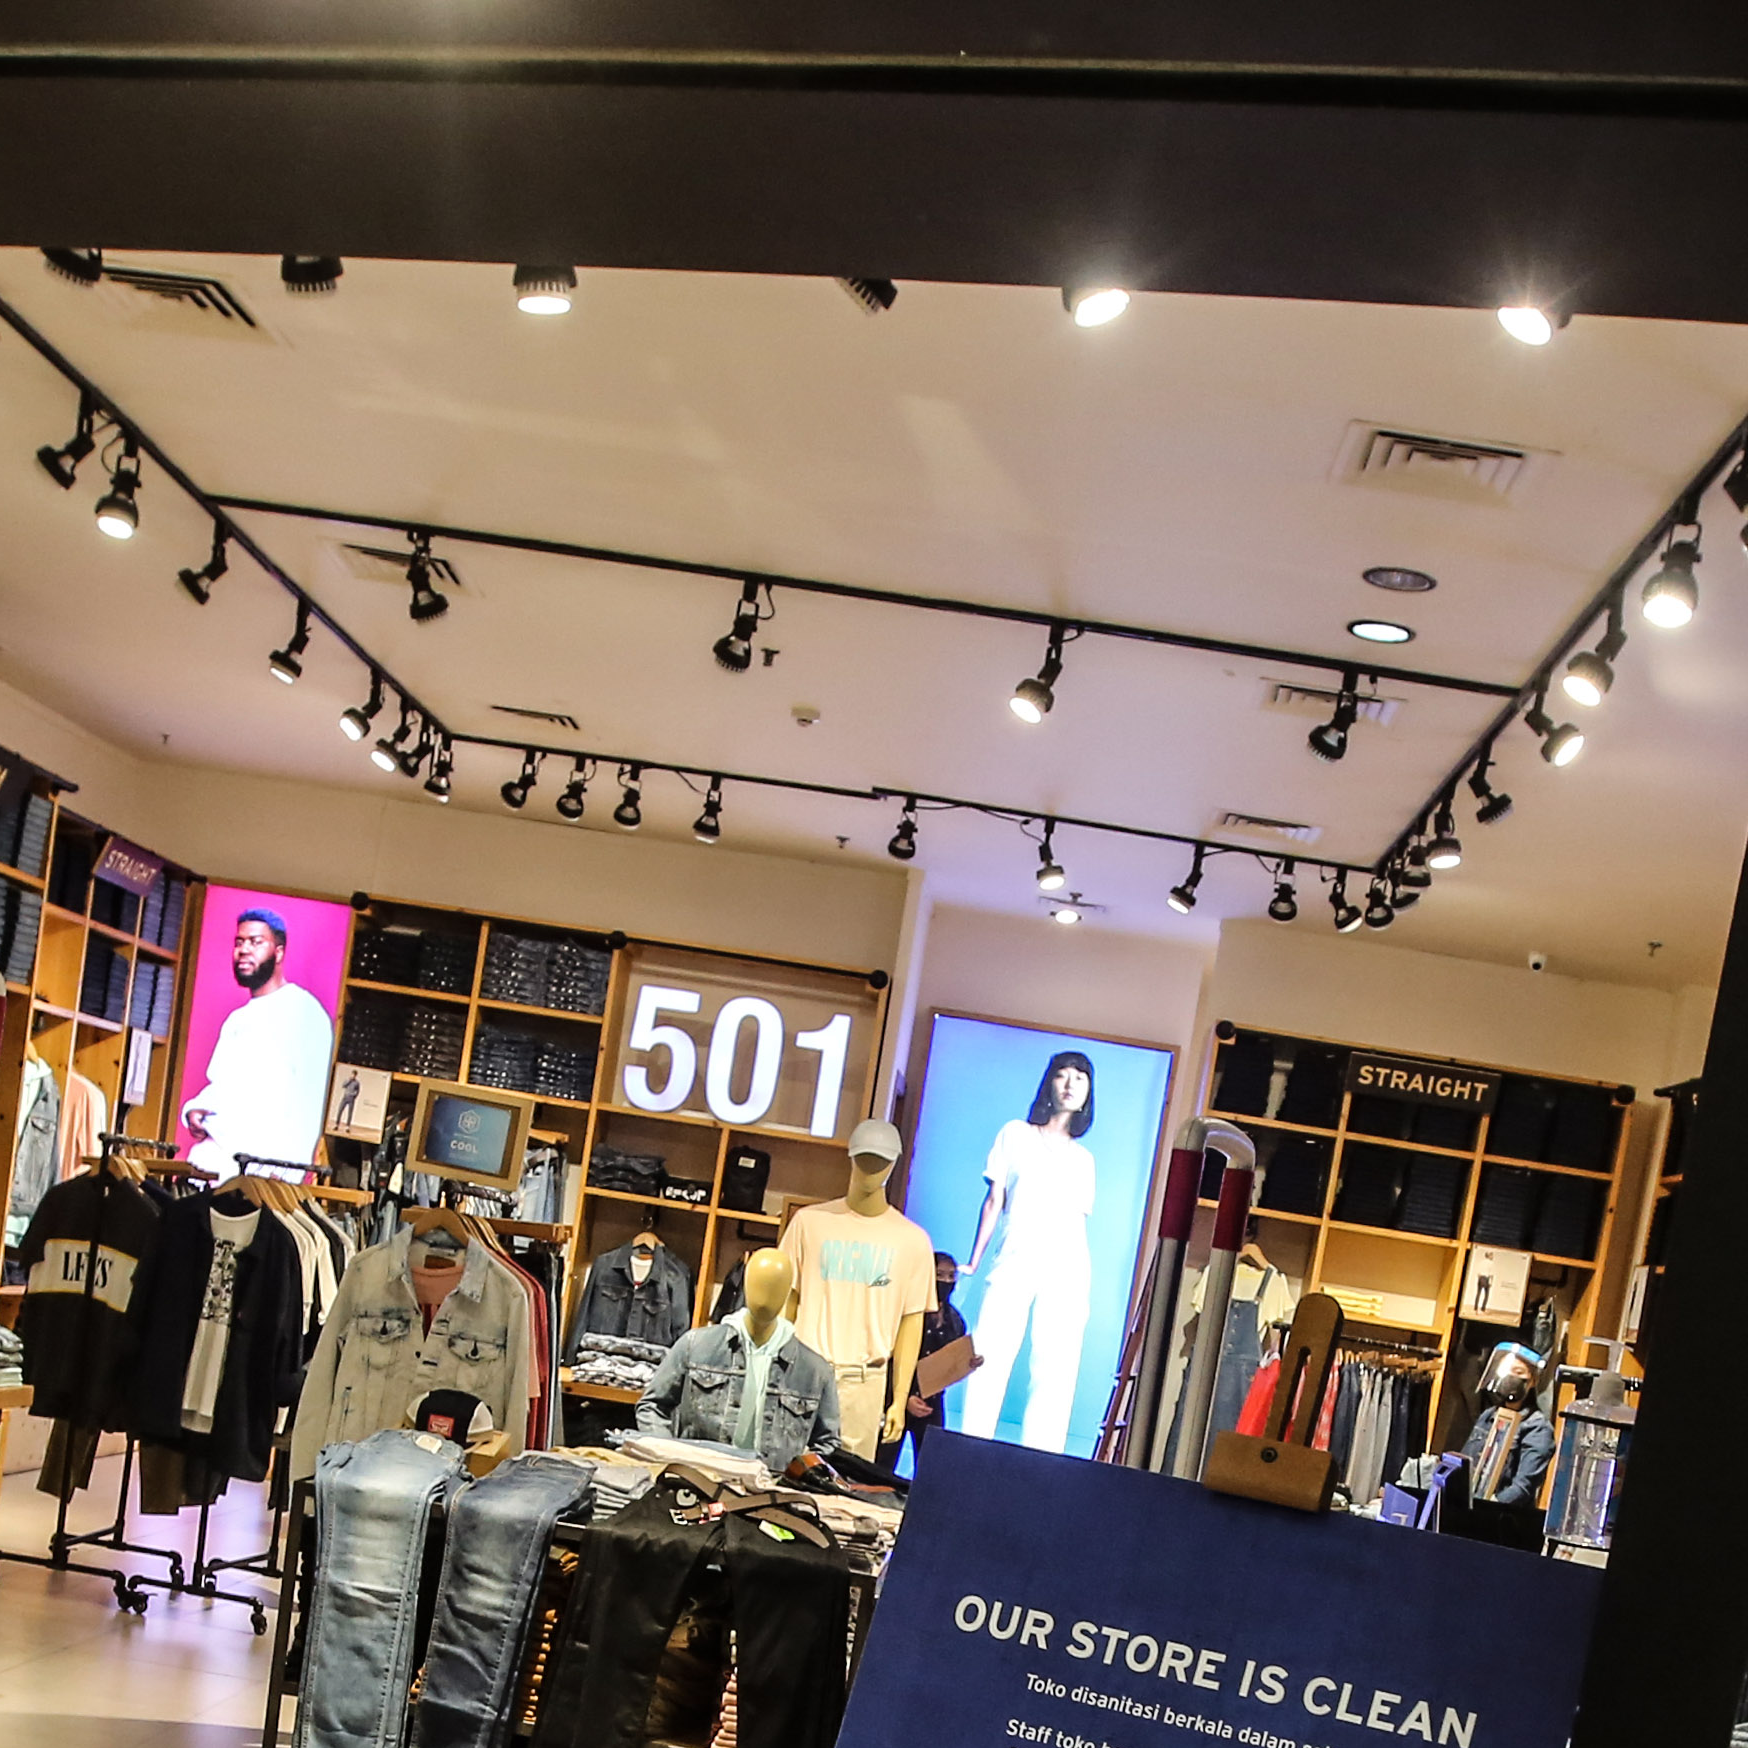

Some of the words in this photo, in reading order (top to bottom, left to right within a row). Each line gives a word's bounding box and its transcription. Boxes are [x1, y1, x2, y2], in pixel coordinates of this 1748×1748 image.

[622, 984, 852, 1138] 501
[1358, 1065, 1489, 1102] STRAIGHT
[450, 1139, 478, 1153] COOL
[955, 1596, 1054, 1650] OUR
[1066, 1622, 1226, 1690] STORE
[1239, 1660, 1288, 1704] IS
[1028, 1674, 1066, 1698] Toko
[1072, 1686, 1160, 1720] disanitasi
[1164, 1708, 1232, 1738] berkala
[1006, 1719, 1052, 1744] Staff
